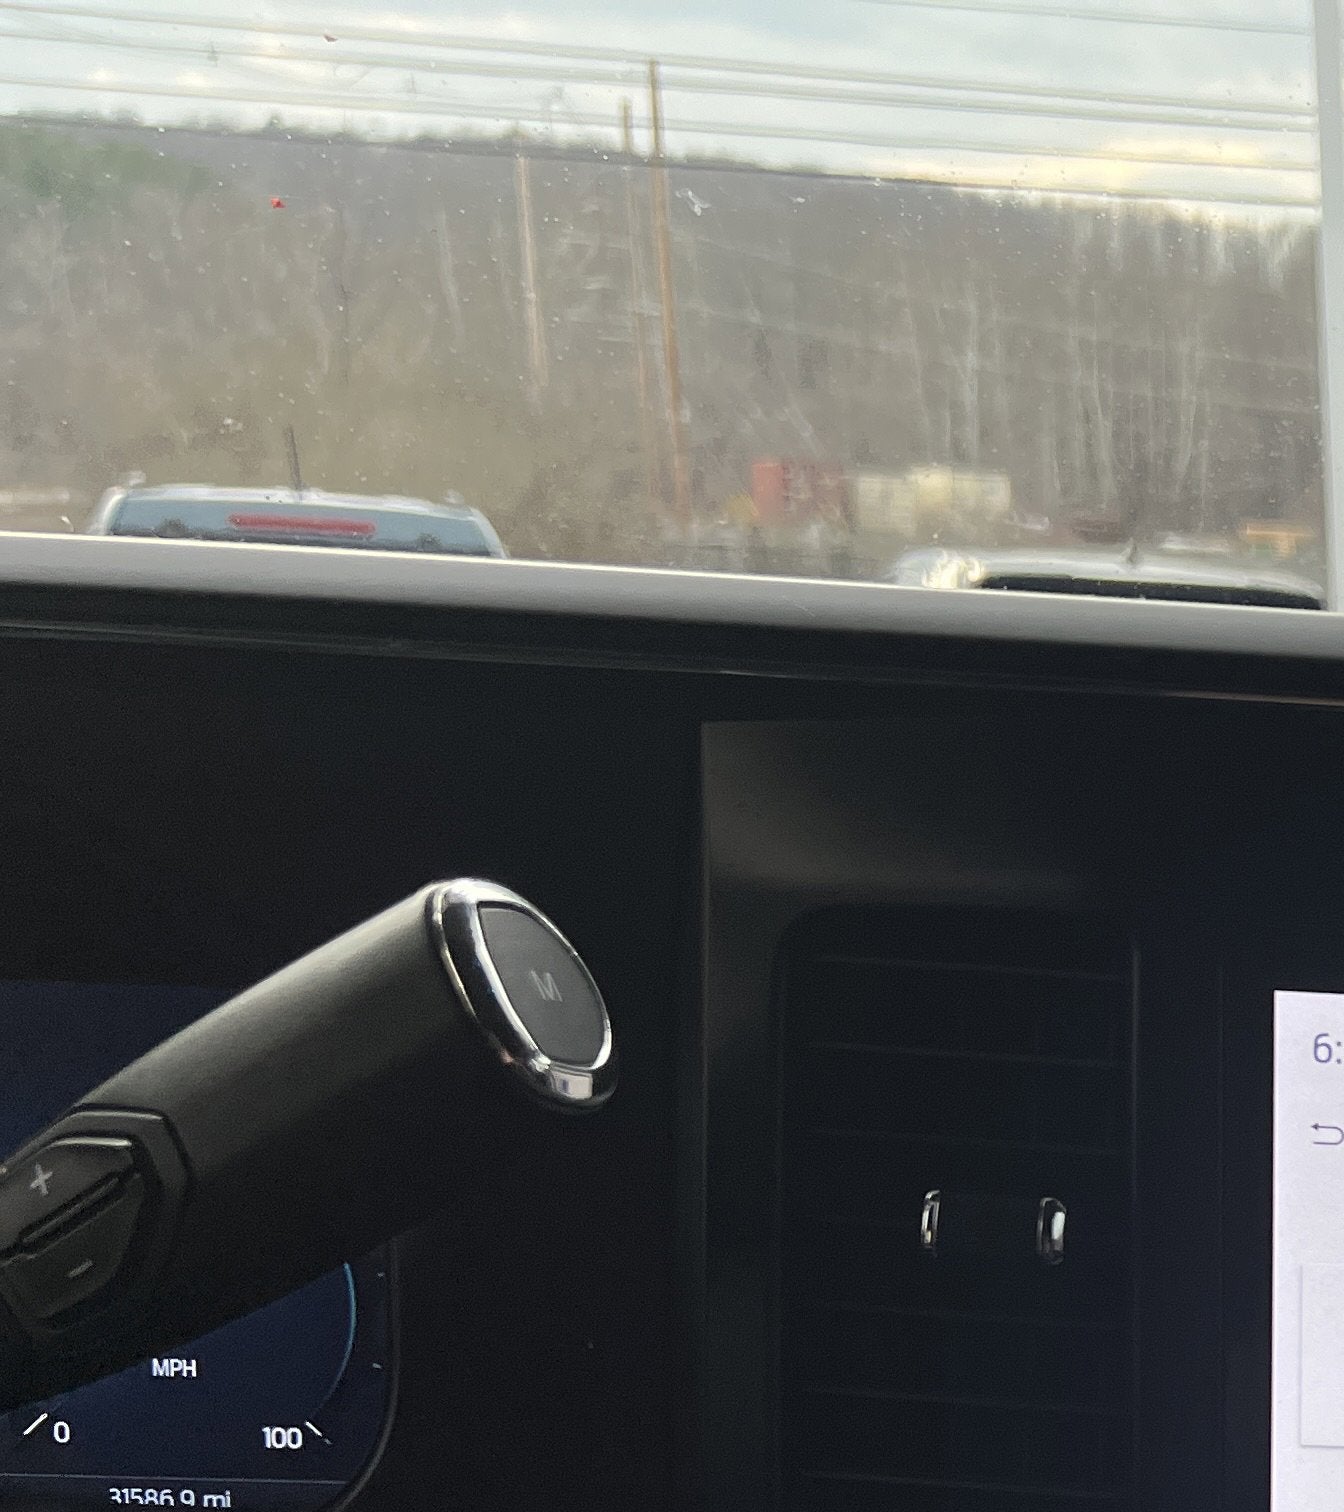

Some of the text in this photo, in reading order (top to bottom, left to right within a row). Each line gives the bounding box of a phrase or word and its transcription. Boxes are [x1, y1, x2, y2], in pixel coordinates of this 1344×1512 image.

[151, 1358, 197, 1379] MPH
[53, 1421, 71, 1444] 0
[262, 1426, 303, 1450] 100
[202, 1490, 231, 1508] mi
